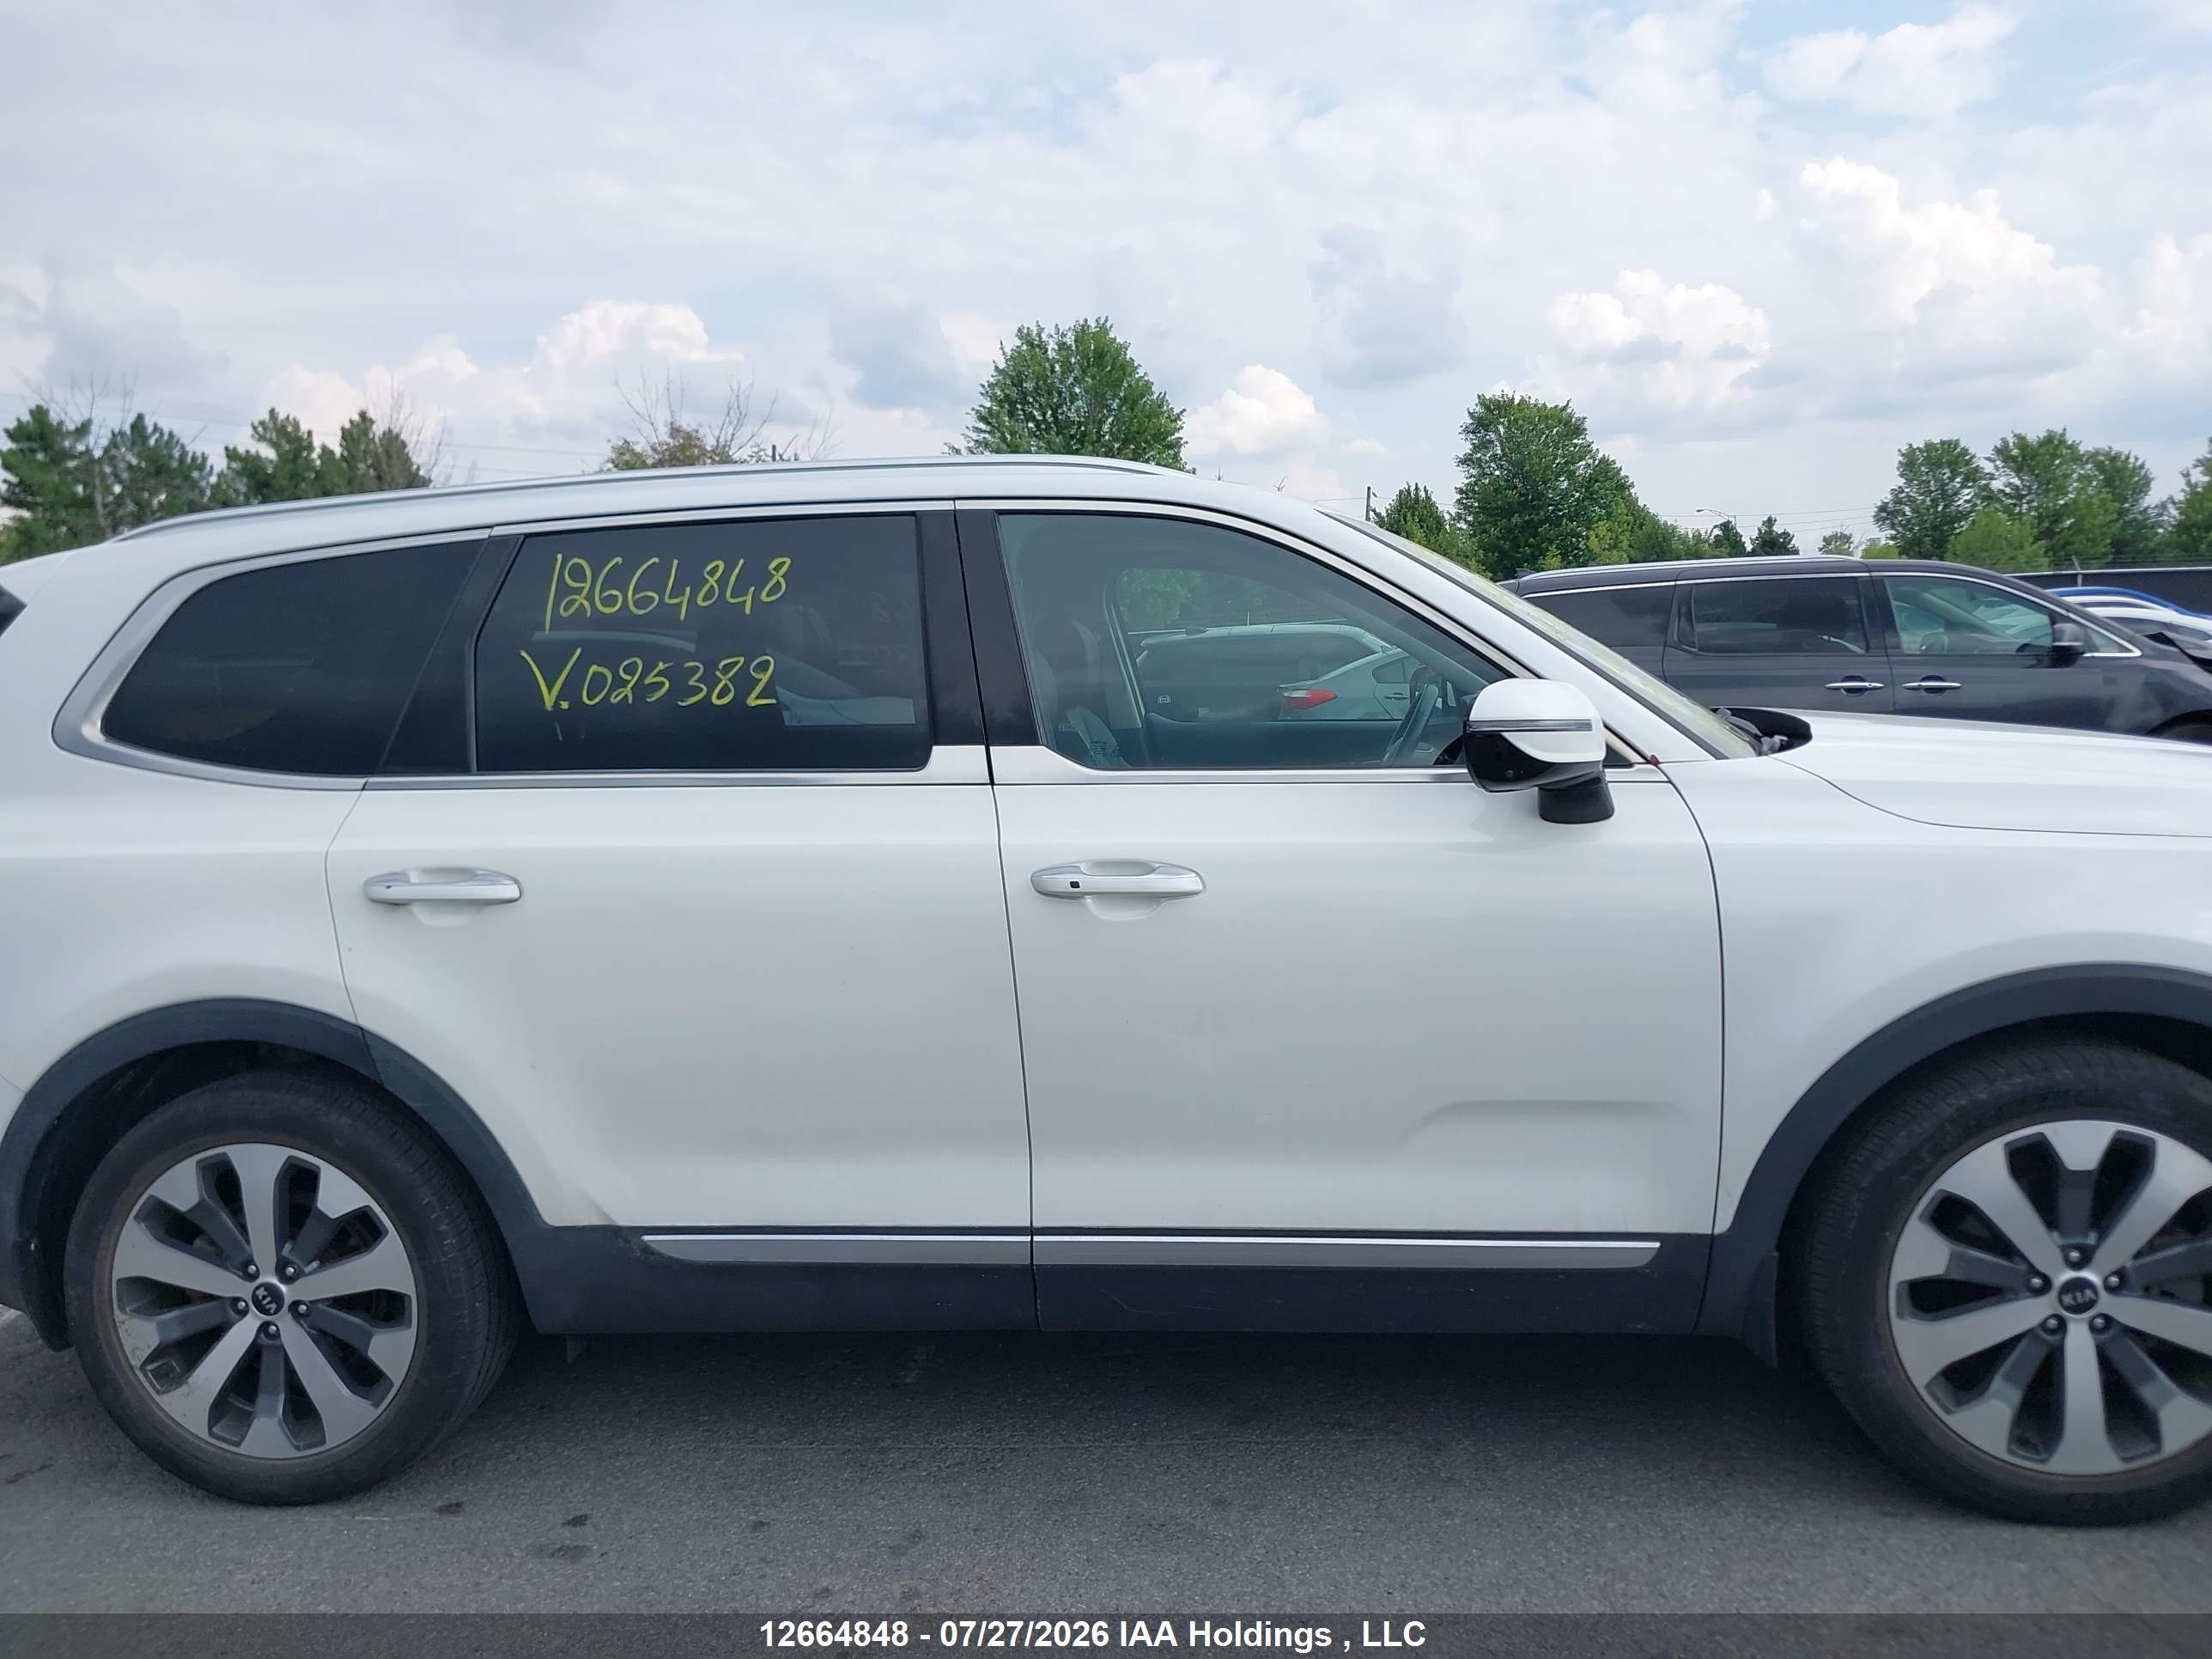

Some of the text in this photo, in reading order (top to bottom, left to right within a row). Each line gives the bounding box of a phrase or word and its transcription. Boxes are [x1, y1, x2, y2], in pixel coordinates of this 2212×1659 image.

[545, 554, 792, 634] 12664848
[520, 647, 777, 710] V.025382
[256, 1286, 276, 1314] KIA
[2061, 1289, 2096, 1306] KIA
